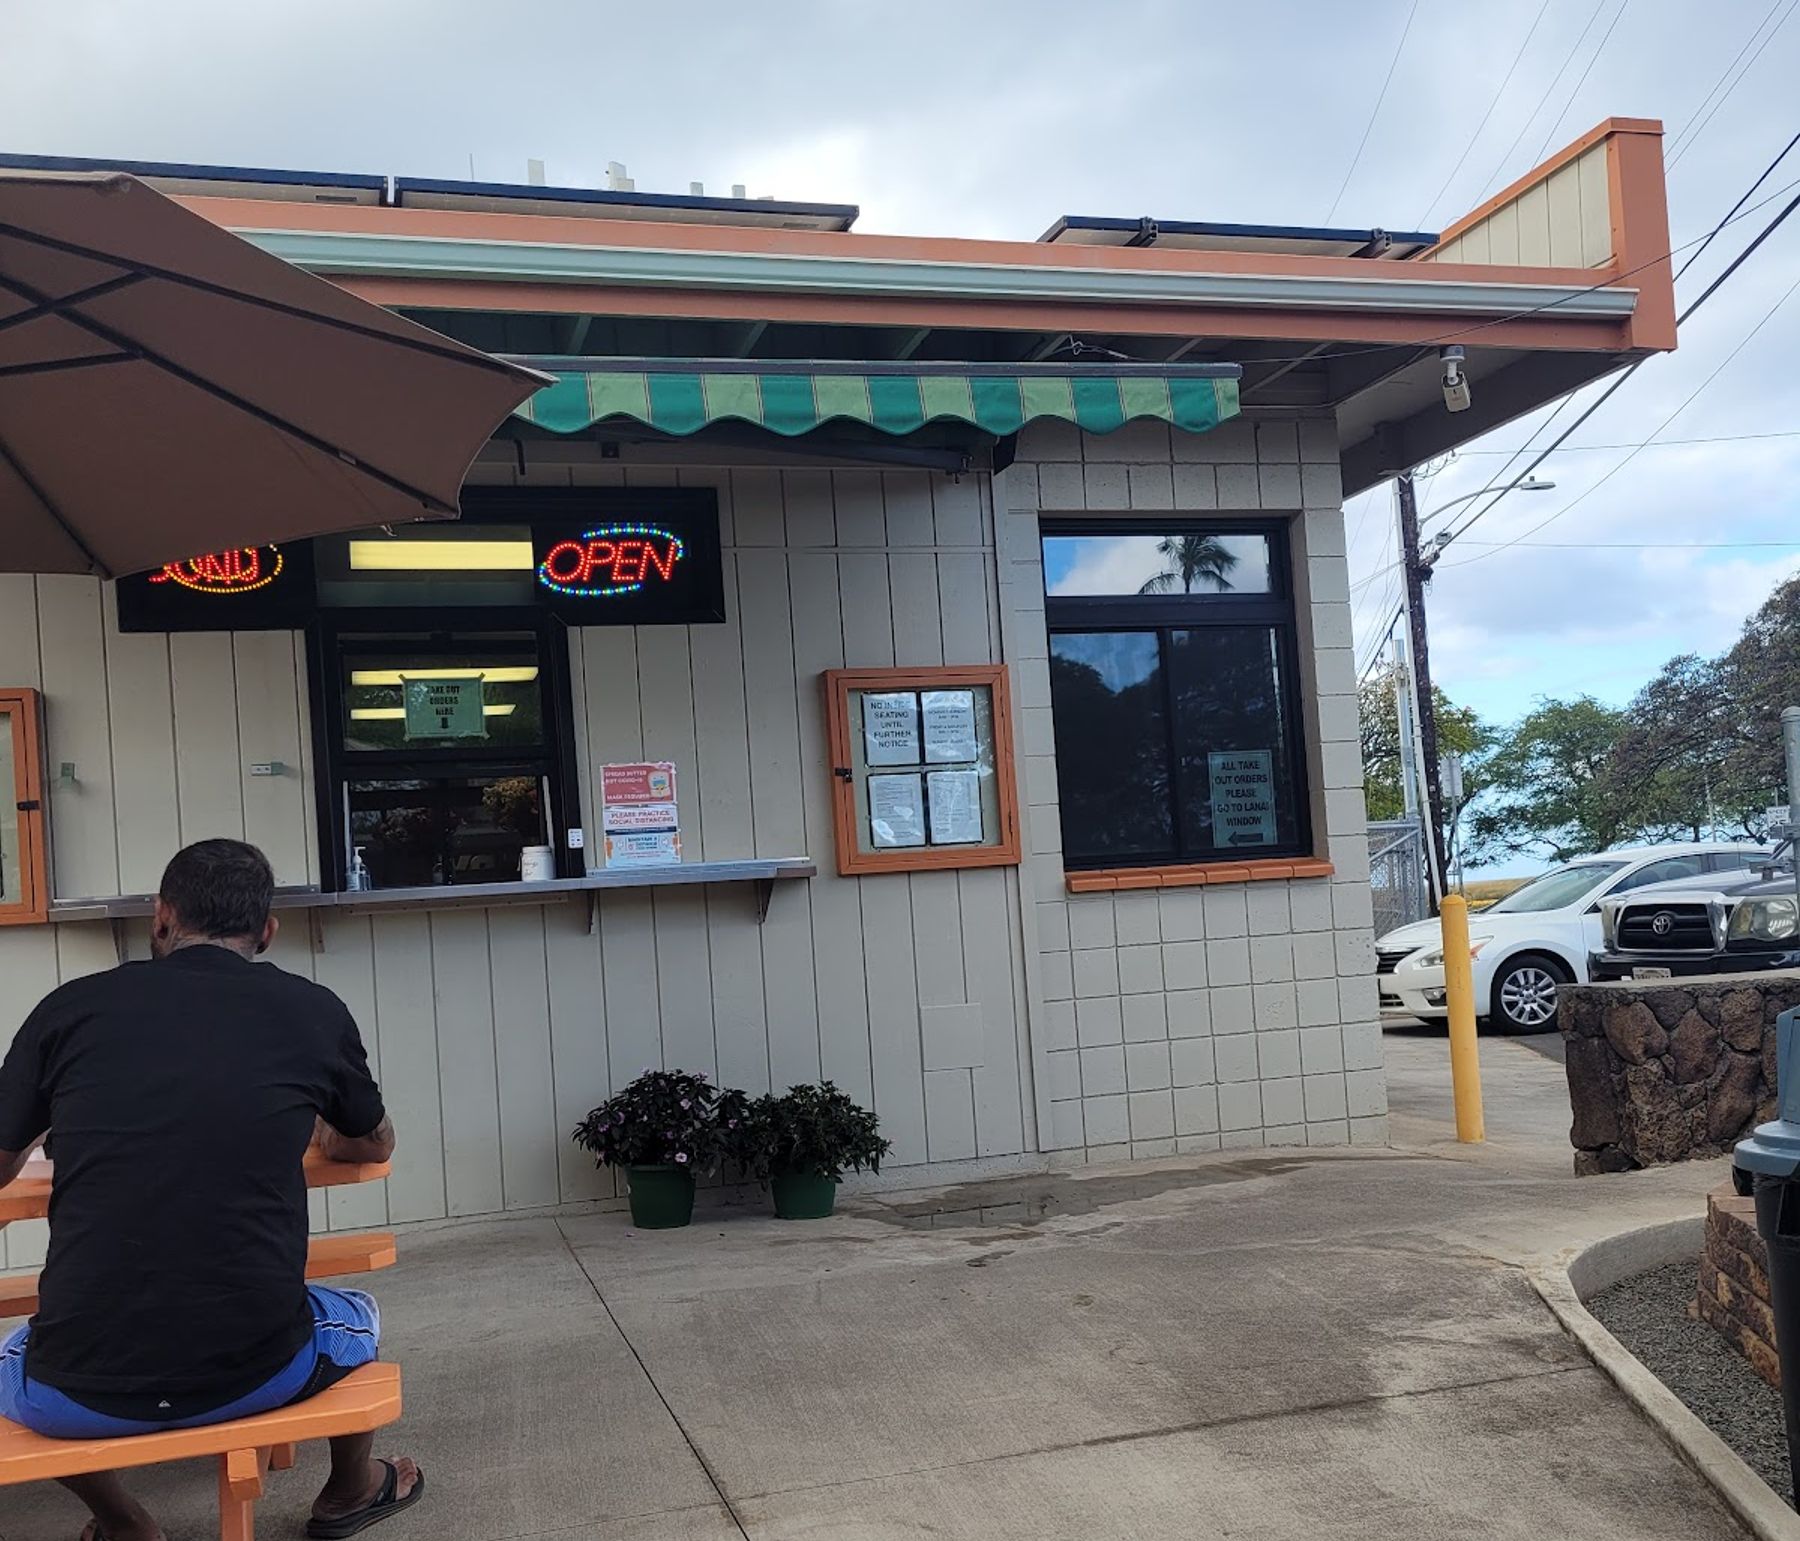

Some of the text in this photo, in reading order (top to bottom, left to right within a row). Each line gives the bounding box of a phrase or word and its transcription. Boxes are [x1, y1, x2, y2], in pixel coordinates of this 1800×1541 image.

[547, 541, 677, 581] OPEN
[870, 702, 882, 710] NO
[874, 711, 909, 719] SEATING
[880, 720, 904, 729] UNTIL
[873, 730, 912, 739] FURTHER
[878, 740, 908, 748] NOTICE
[1221, 760, 1260, 771] ALL TAKE
[1214, 774, 1268, 785] OUT ORDERS
[1225, 789, 1257, 799] PLEASE
[1217, 801, 1270, 813] GO TO LANAI
[611, 810, 670, 819] PLEASE PRACTICE
[1226, 816, 1262, 827] WINDOW
